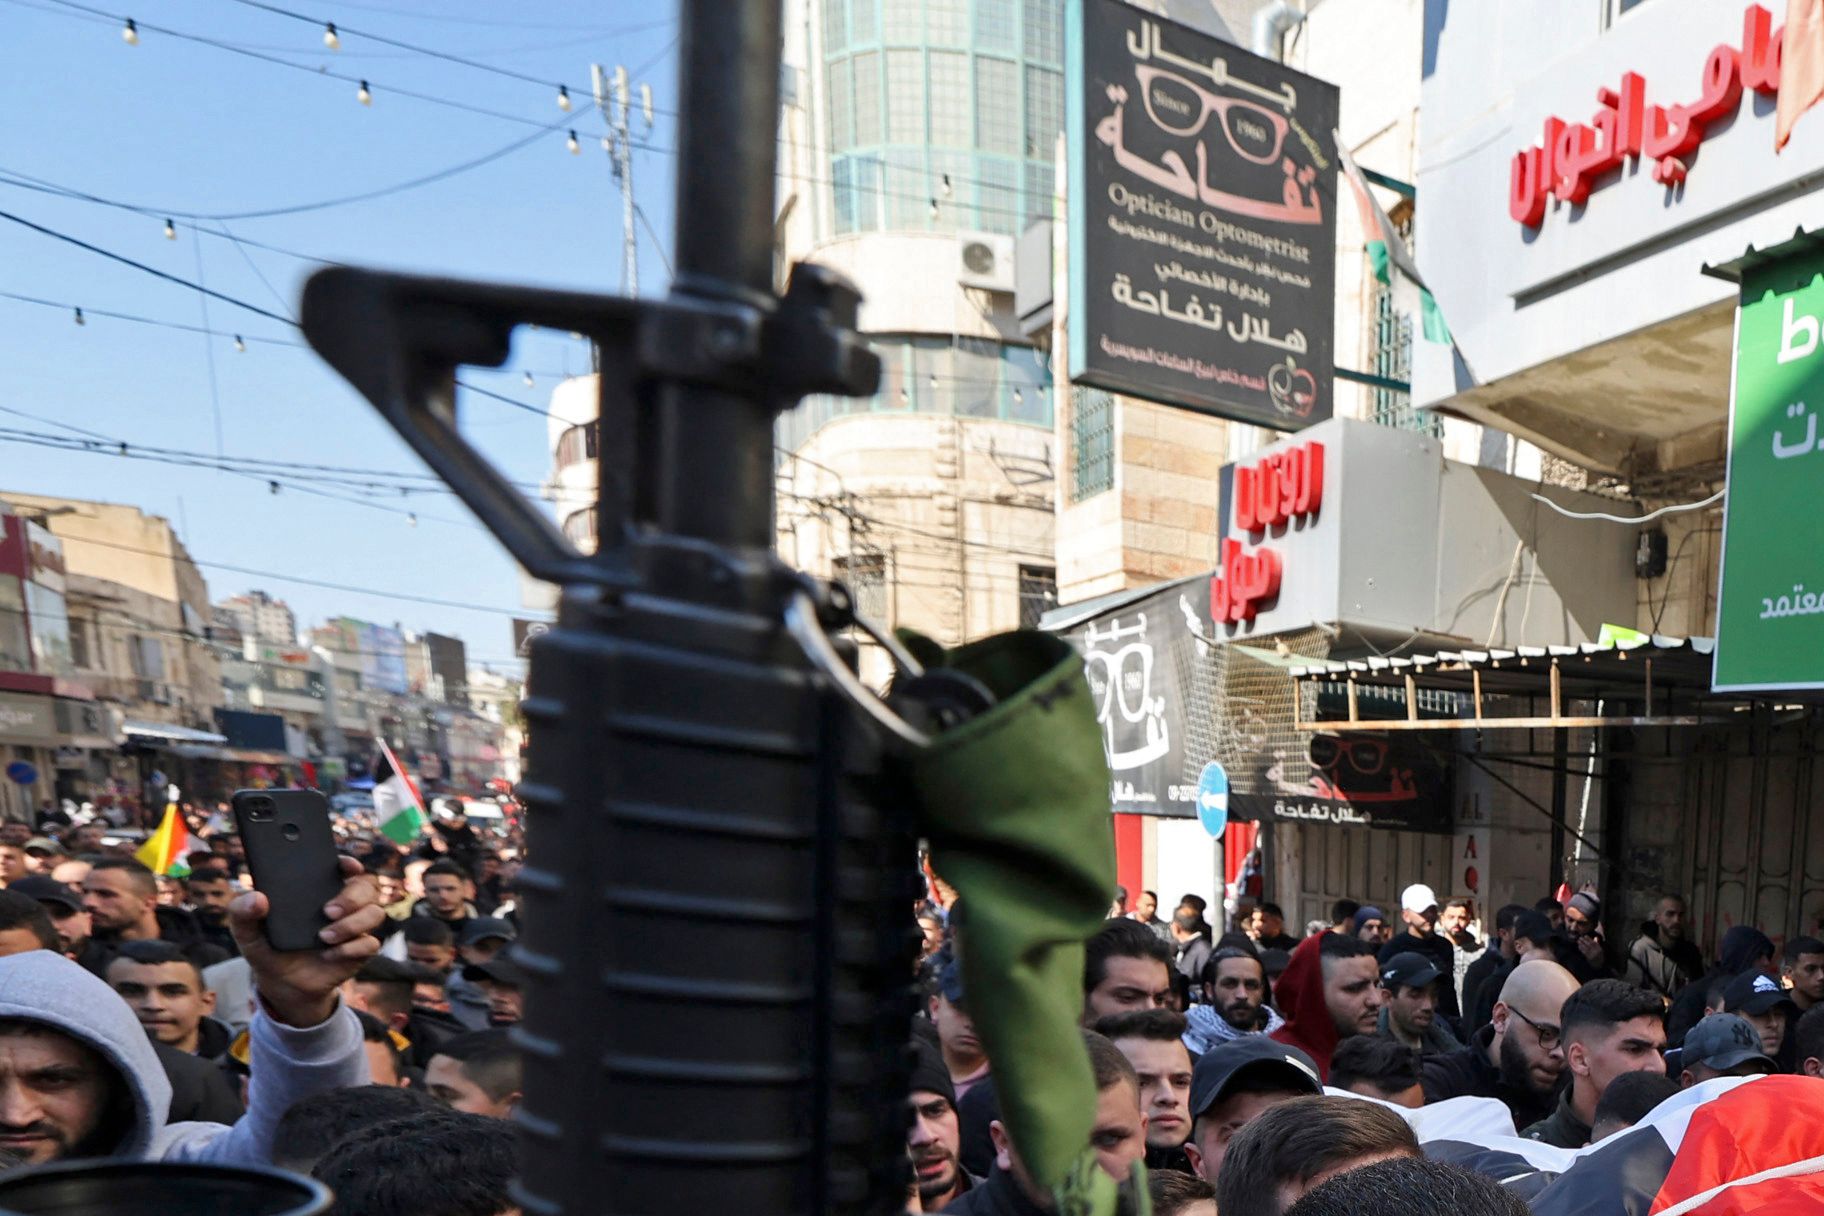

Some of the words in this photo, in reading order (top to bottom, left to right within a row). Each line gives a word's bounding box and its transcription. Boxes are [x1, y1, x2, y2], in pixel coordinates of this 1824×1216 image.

[1108, 182, 1195, 228] Optician
[1199, 211, 1310, 264] Optometrist
[1111, 273, 1223, 331] تفاحة
[1226, 312, 1308, 354] هلال
